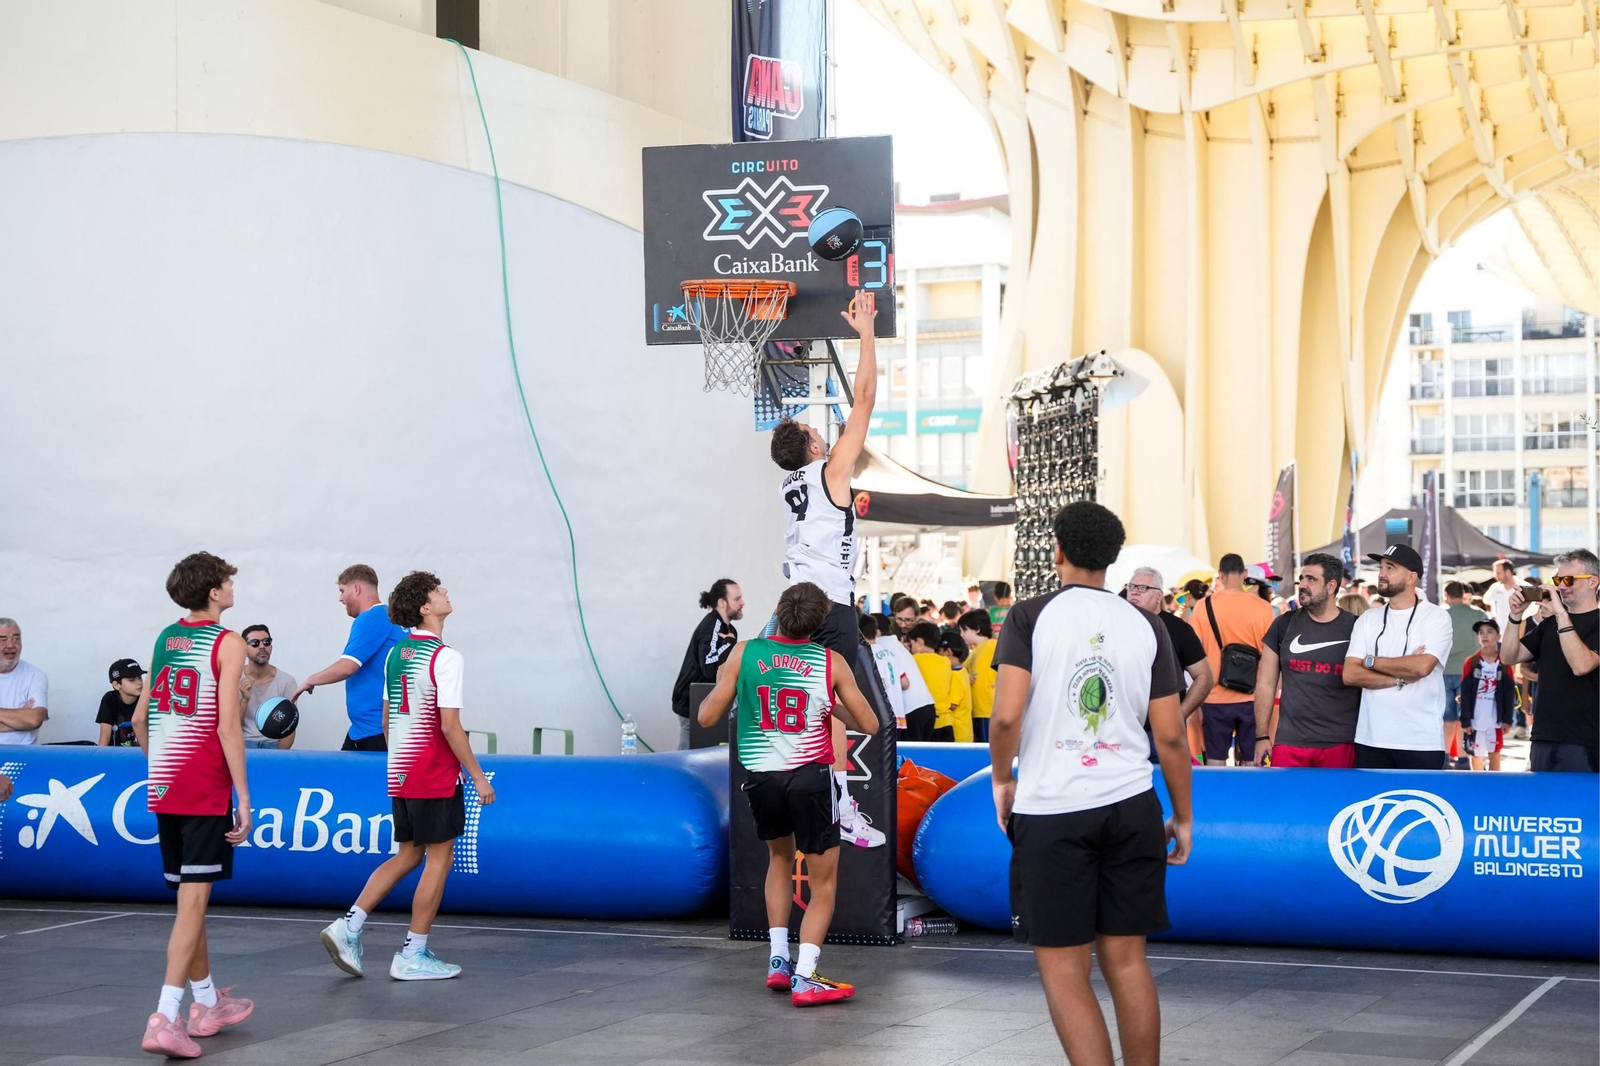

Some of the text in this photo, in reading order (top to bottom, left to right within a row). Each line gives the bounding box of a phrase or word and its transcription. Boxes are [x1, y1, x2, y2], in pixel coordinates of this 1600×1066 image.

[731, 159, 799, 174] CIRCUITO
[713, 252, 820, 275] CaixaBank
[863, 240, 887, 289] 3
[661, 324, 692, 332] CaixaBank
[757, 654, 814, 678] A. ORDEN
[1289, 658, 1312, 672] JUST
[1315, 661, 1331, 674] DO
[149, 665, 201, 718] 49
[398, 673, 411, 715] 1
[756, 685, 810, 735] 18
[1473, 815, 1583, 834] UNIVERSO
[1473, 834, 1583, 860] MUJER
